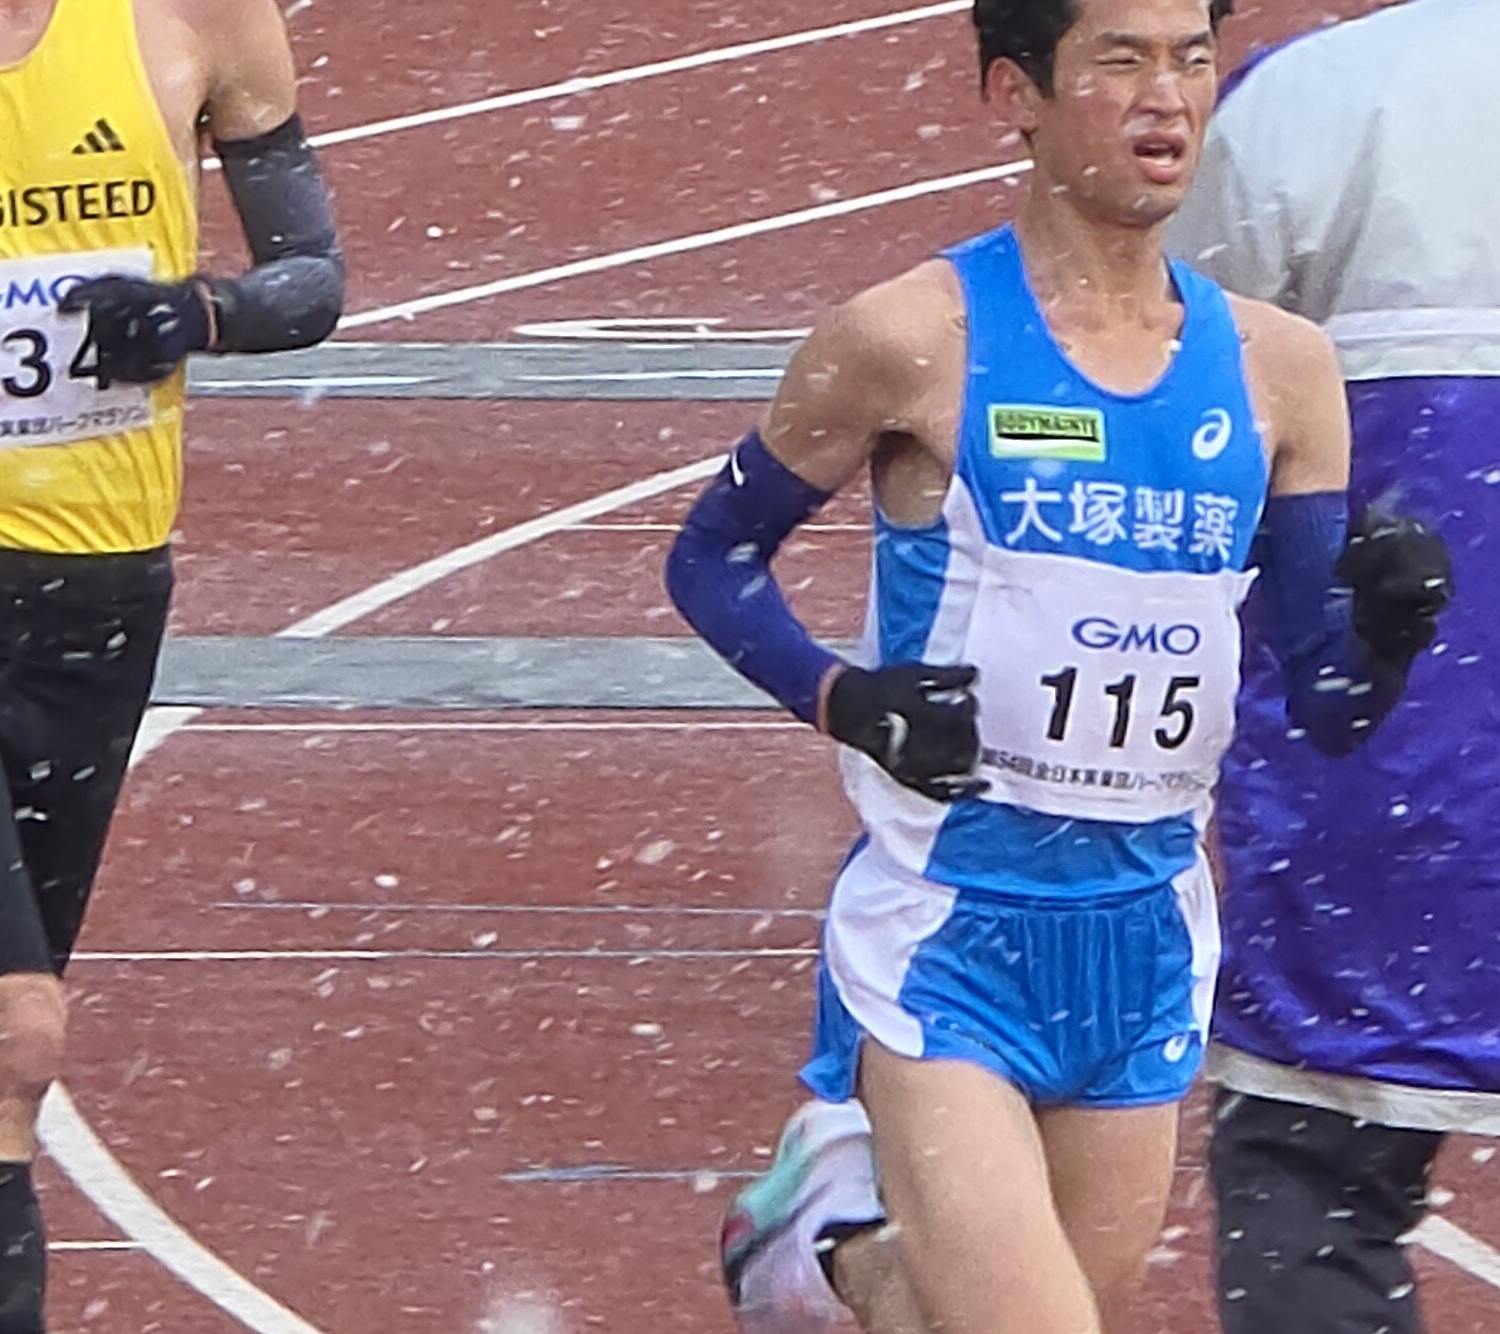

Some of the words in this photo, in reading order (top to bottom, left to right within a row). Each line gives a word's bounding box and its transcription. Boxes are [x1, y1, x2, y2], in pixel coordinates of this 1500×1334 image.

[1000, 478, 1240, 559] 大塚製薬
[1070, 617, 1201, 655] GMO
[1040, 665, 1201, 751] 115
